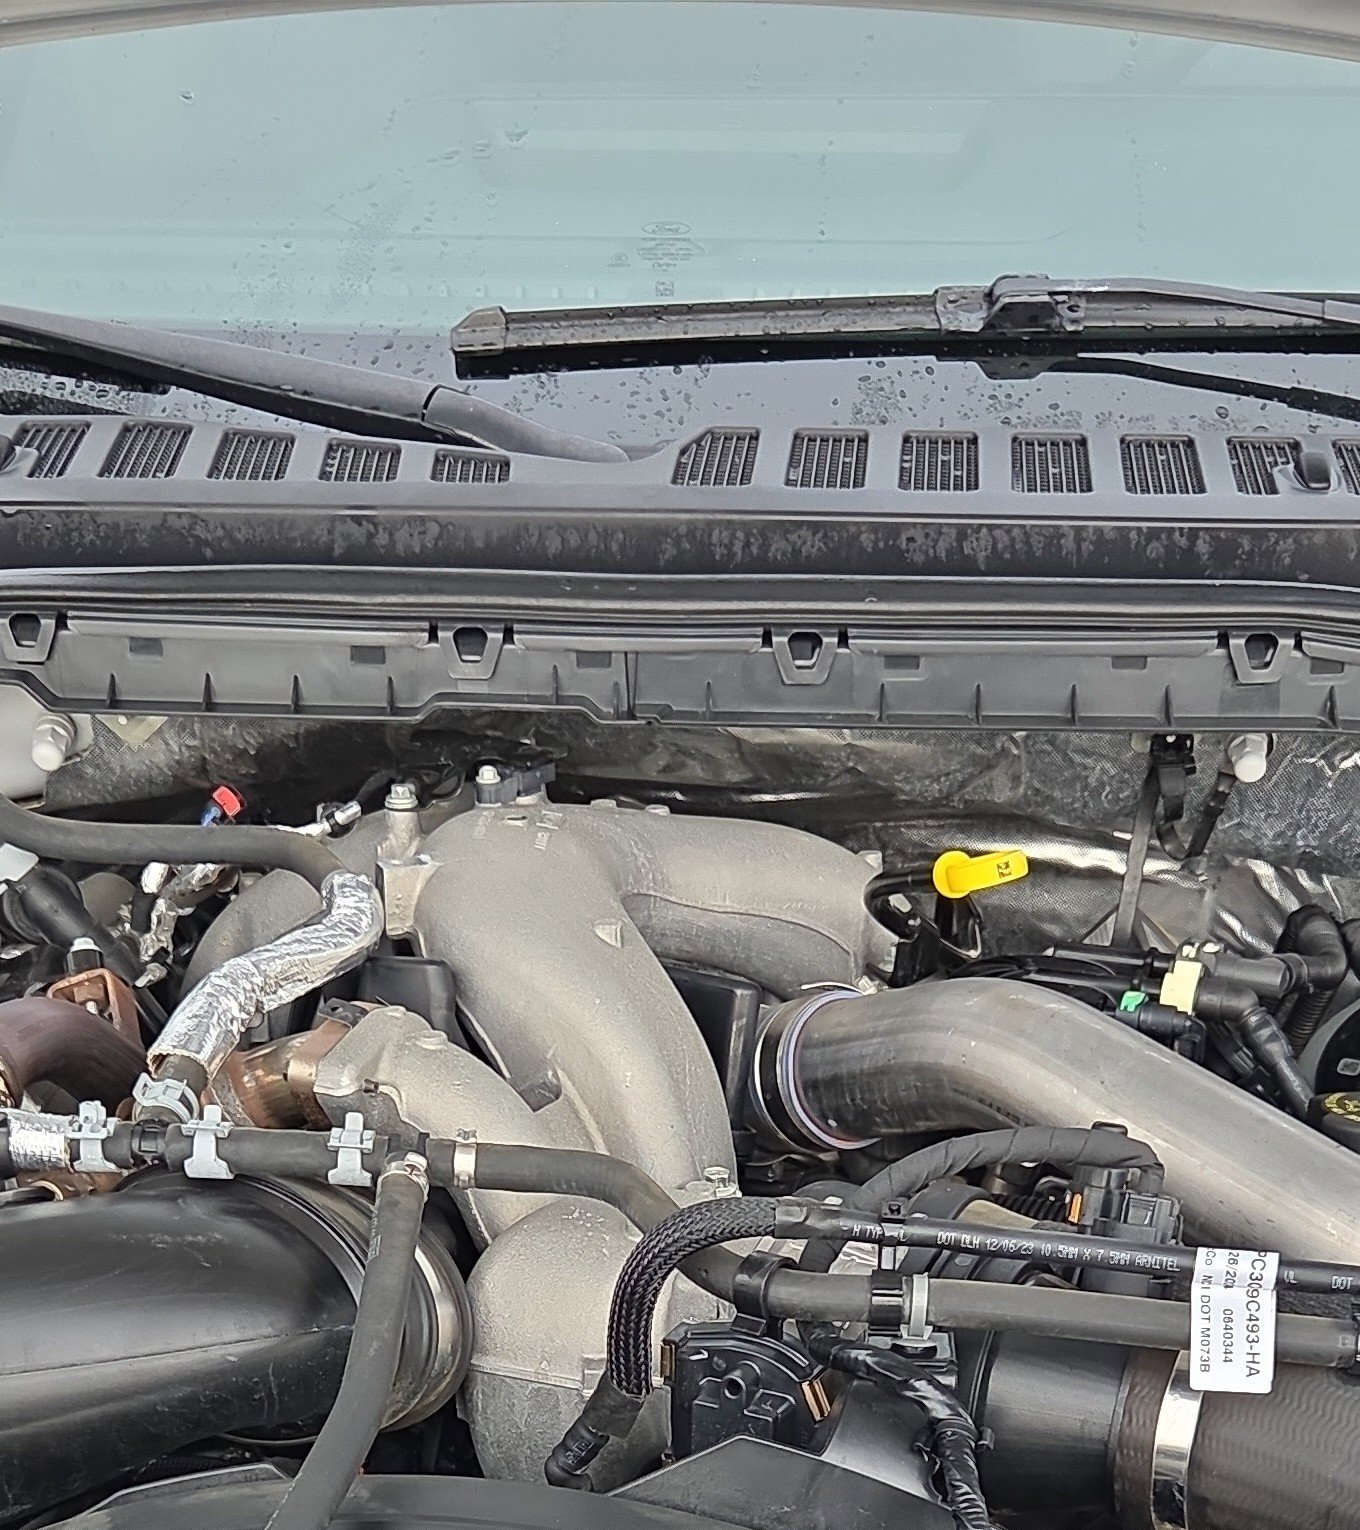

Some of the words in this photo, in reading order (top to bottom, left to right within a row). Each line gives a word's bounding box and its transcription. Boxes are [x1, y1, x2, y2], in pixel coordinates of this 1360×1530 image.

[936, 1231, 957, 1245] DOT
[985, 1237, 1035, 1255] 12/06/23
[1222, 1308, 1234, 1364] 0640344
